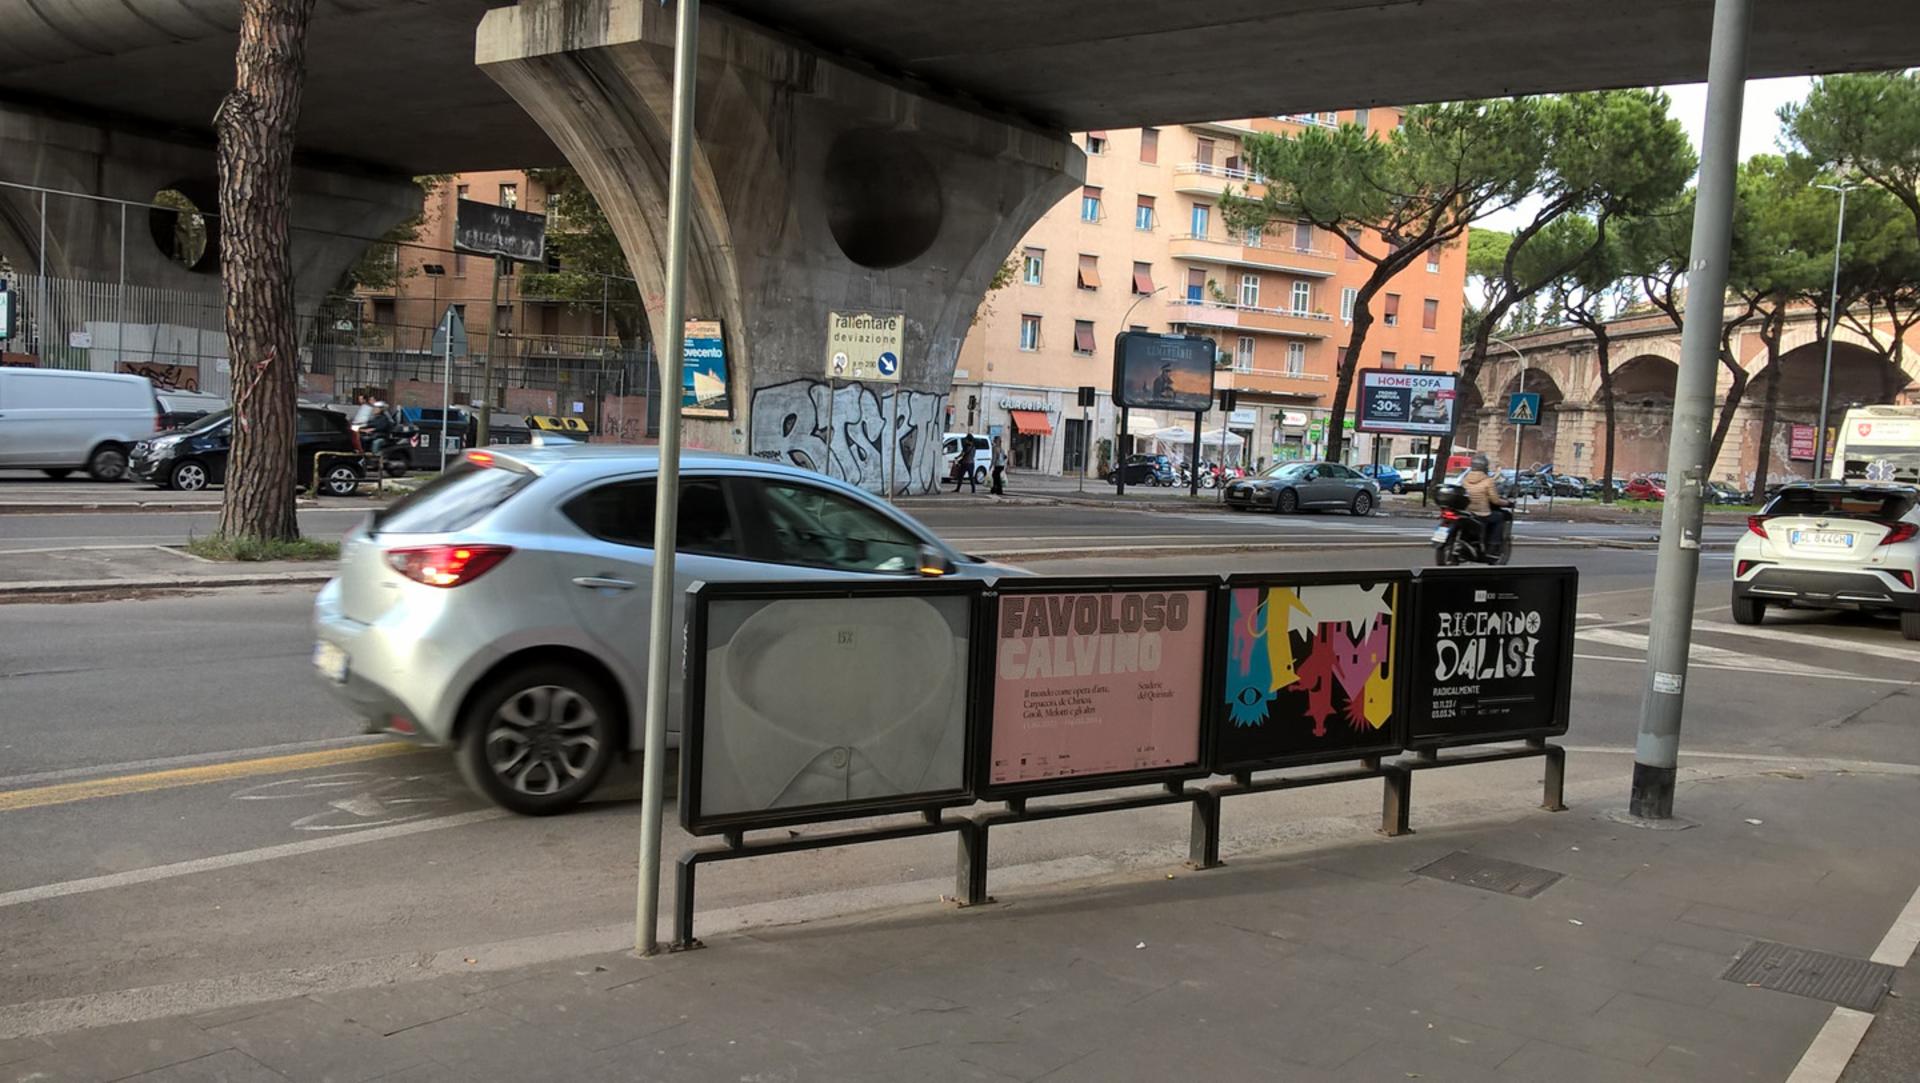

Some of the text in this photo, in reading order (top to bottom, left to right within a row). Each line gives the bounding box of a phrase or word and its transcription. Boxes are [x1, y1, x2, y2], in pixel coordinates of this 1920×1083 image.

[834, 333, 897, 345] deviazione
[683, 347, 723, 358] ovecento
[1371, 400, 1402, 412] -30%
[1000, 593, 1189, 638] FAVOLOSO
[1437, 610, 1541, 637] RICCARDO
[1000, 632, 1162, 680] CALVINO
[1434, 636, 1540, 681] DALISI
[1432, 685, 1481, 696] RADICALMENTE
